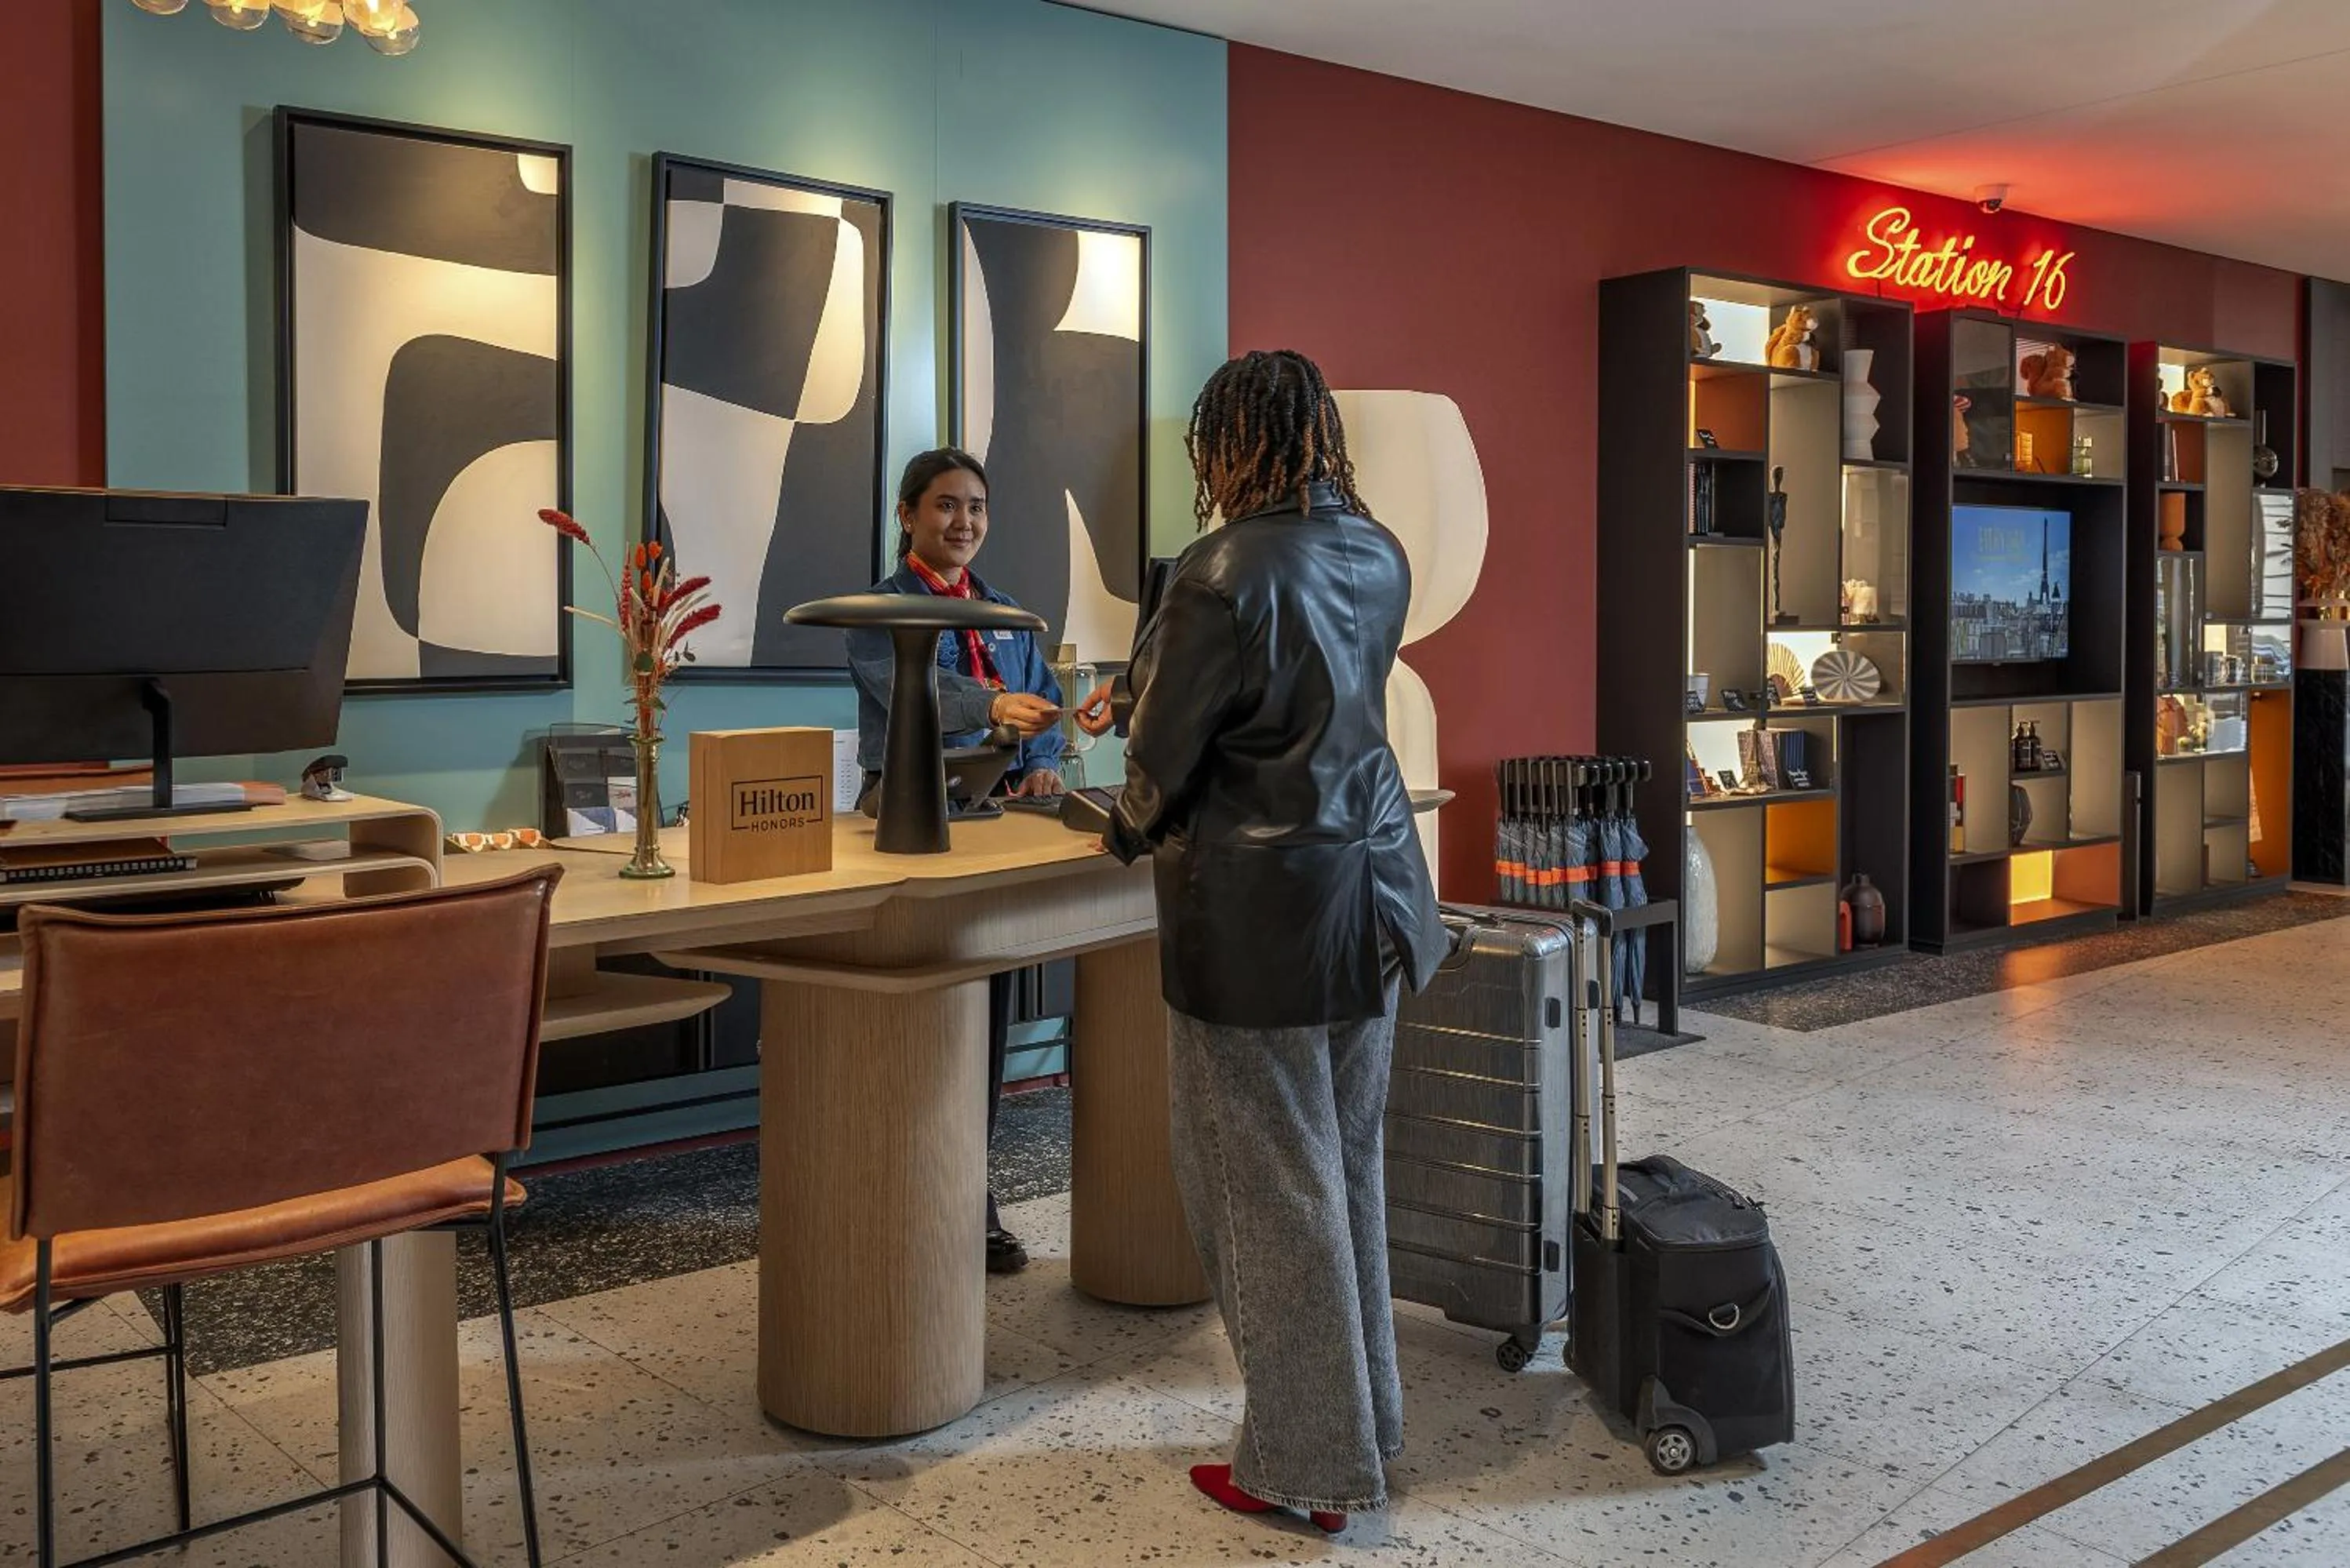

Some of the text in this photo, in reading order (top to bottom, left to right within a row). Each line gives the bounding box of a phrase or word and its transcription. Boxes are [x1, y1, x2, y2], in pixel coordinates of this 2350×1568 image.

[1846, 206, 2076, 310] Station 16
[739, 788, 816, 817] Hilton
[751, 817, 806, 832] HONORS
